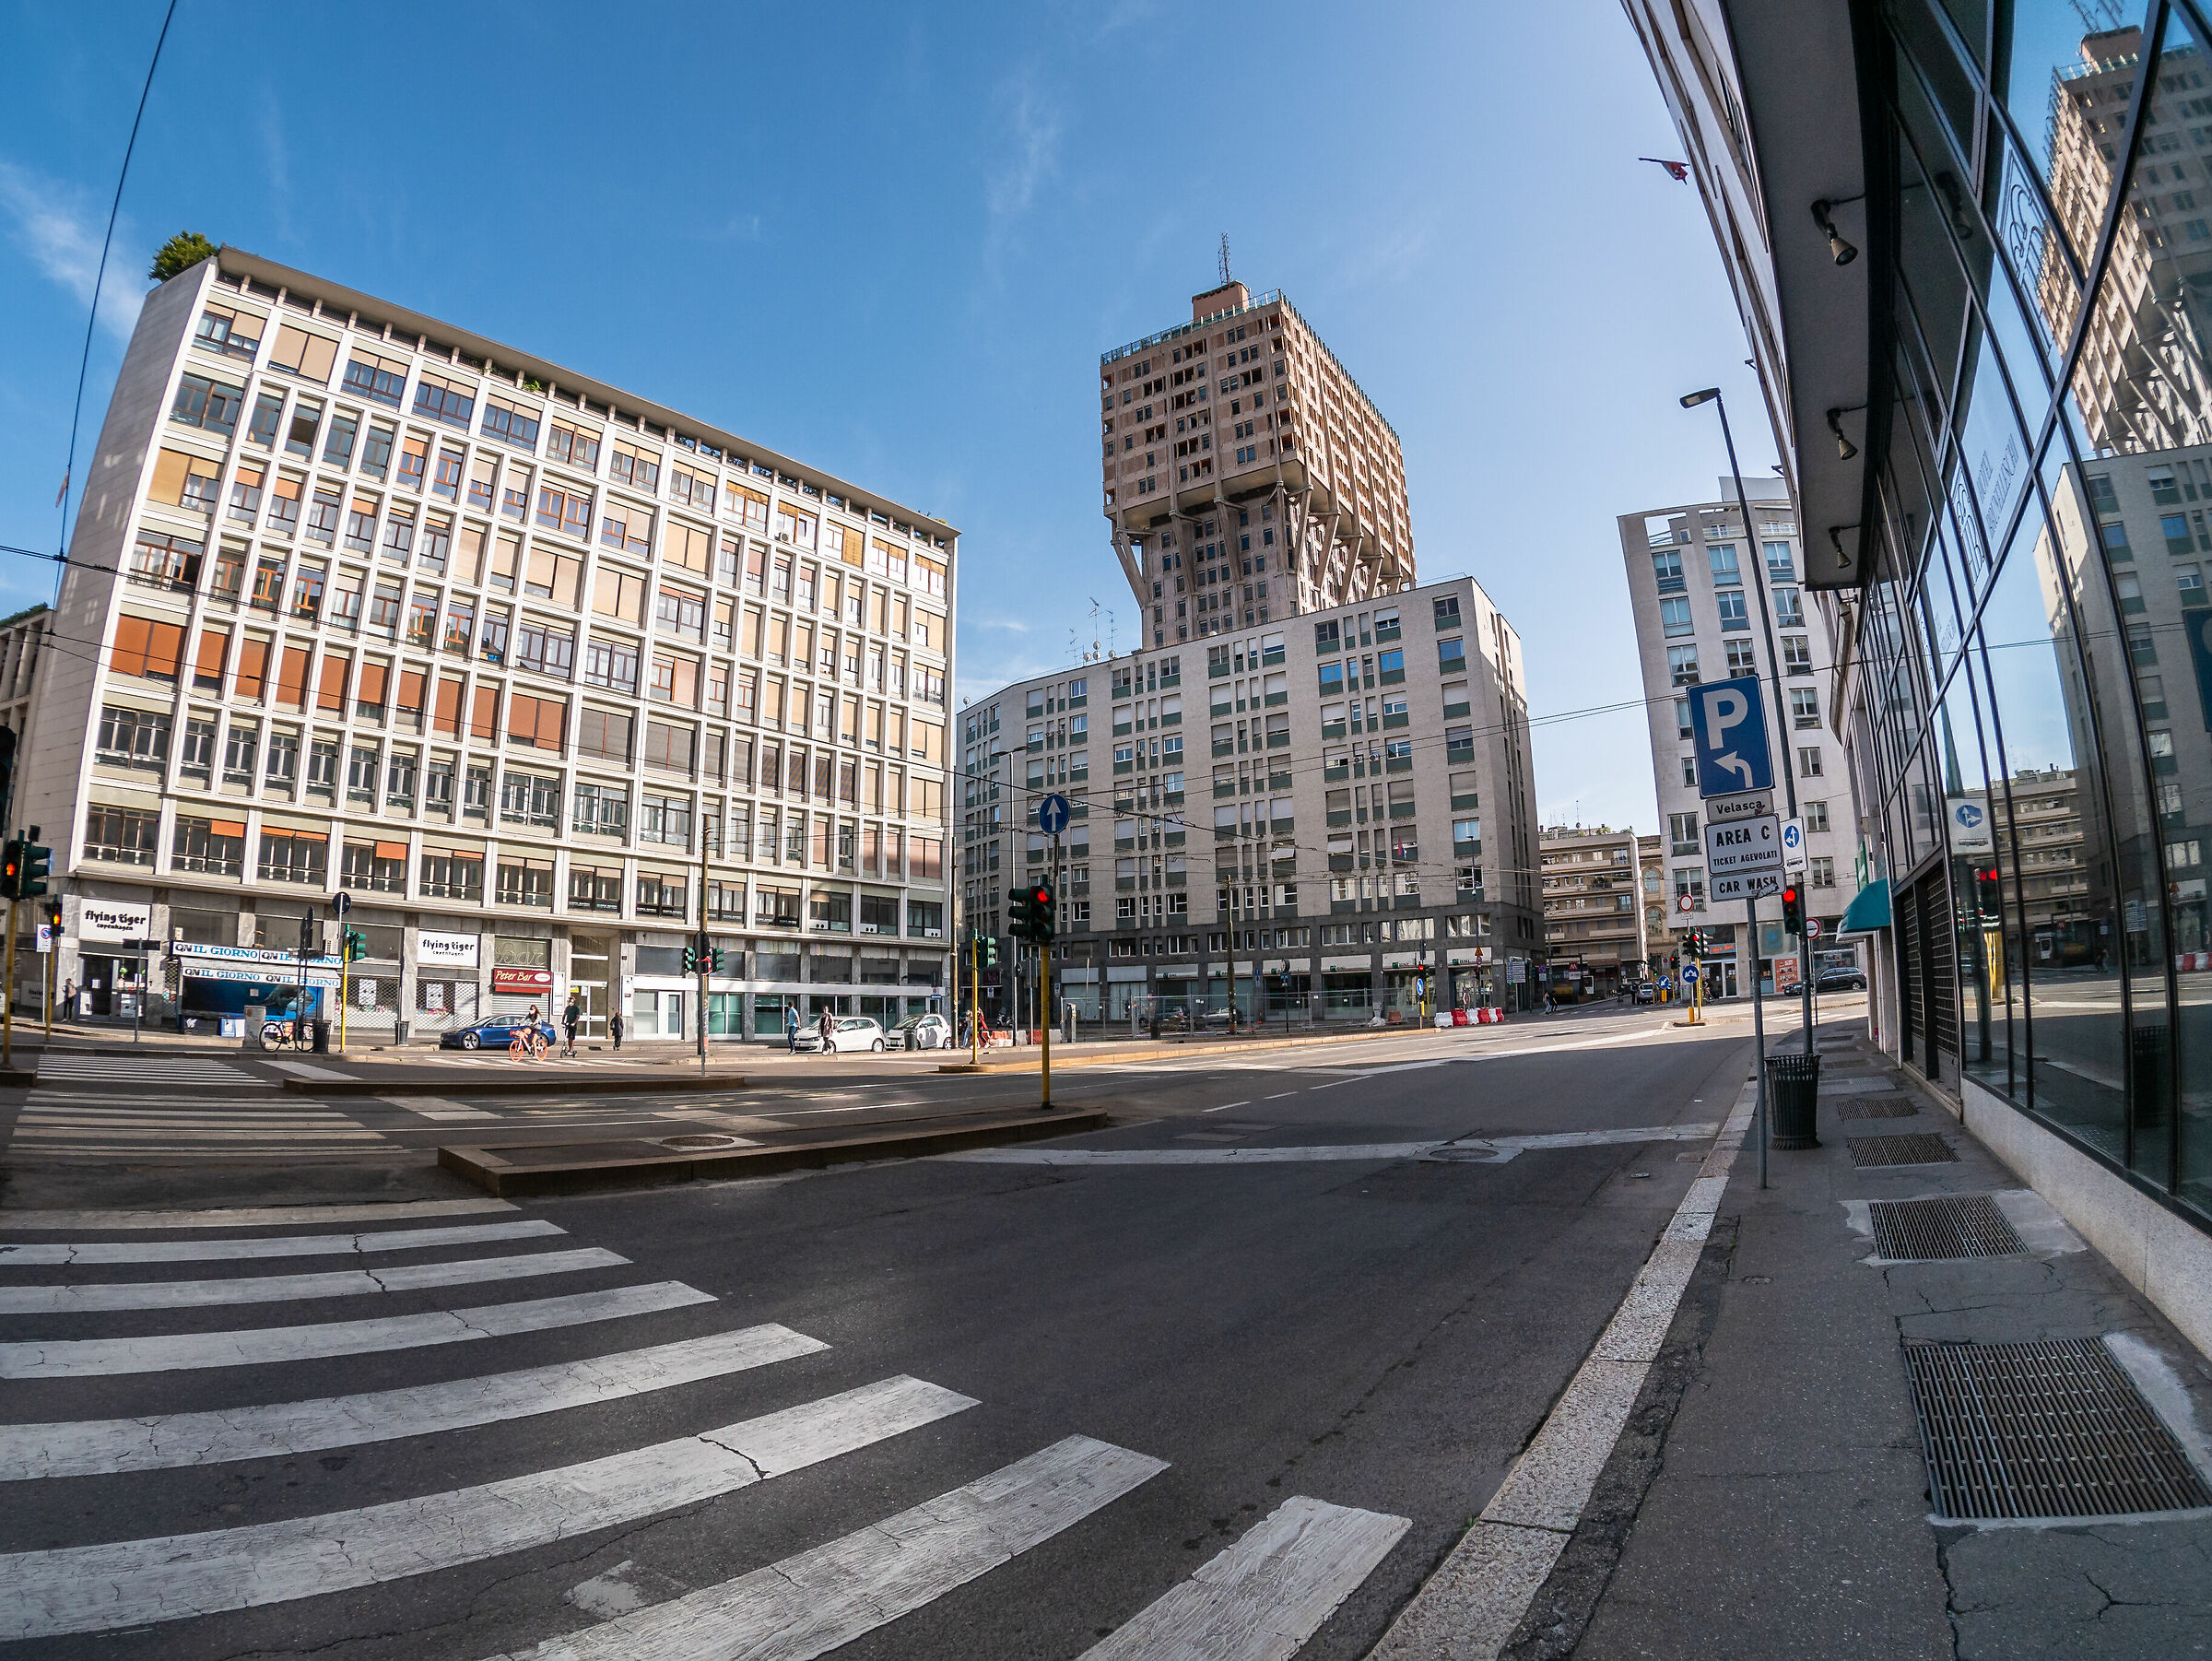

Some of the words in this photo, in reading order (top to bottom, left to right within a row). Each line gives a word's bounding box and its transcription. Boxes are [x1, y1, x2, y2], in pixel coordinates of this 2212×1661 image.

[1702, 688, 1748, 749] P
[1716, 800, 1763, 815] Velasca
[1716, 828, 1752, 847] AREA
[1760, 825, 1771, 841] C
[1713, 855, 1736, 866] TICKET
[1740, 850, 1778, 863] AGEVOLATI
[1719, 878, 1741, 893] CAR
[1747, 876, 1777, 890] WASH
[85, 910, 116, 924] flying
[118, 913, 146, 925] tiger
[97, 923, 133, 931] copenhagen
[422, 938, 450, 950] flying
[451, 941, 475, 951] tiger
[210, 947, 258, 959] GIORNO
[217, 971, 260, 982] GIORNO
[495, 970, 517, 981] Peter
[517, 972, 534, 982] Bar
